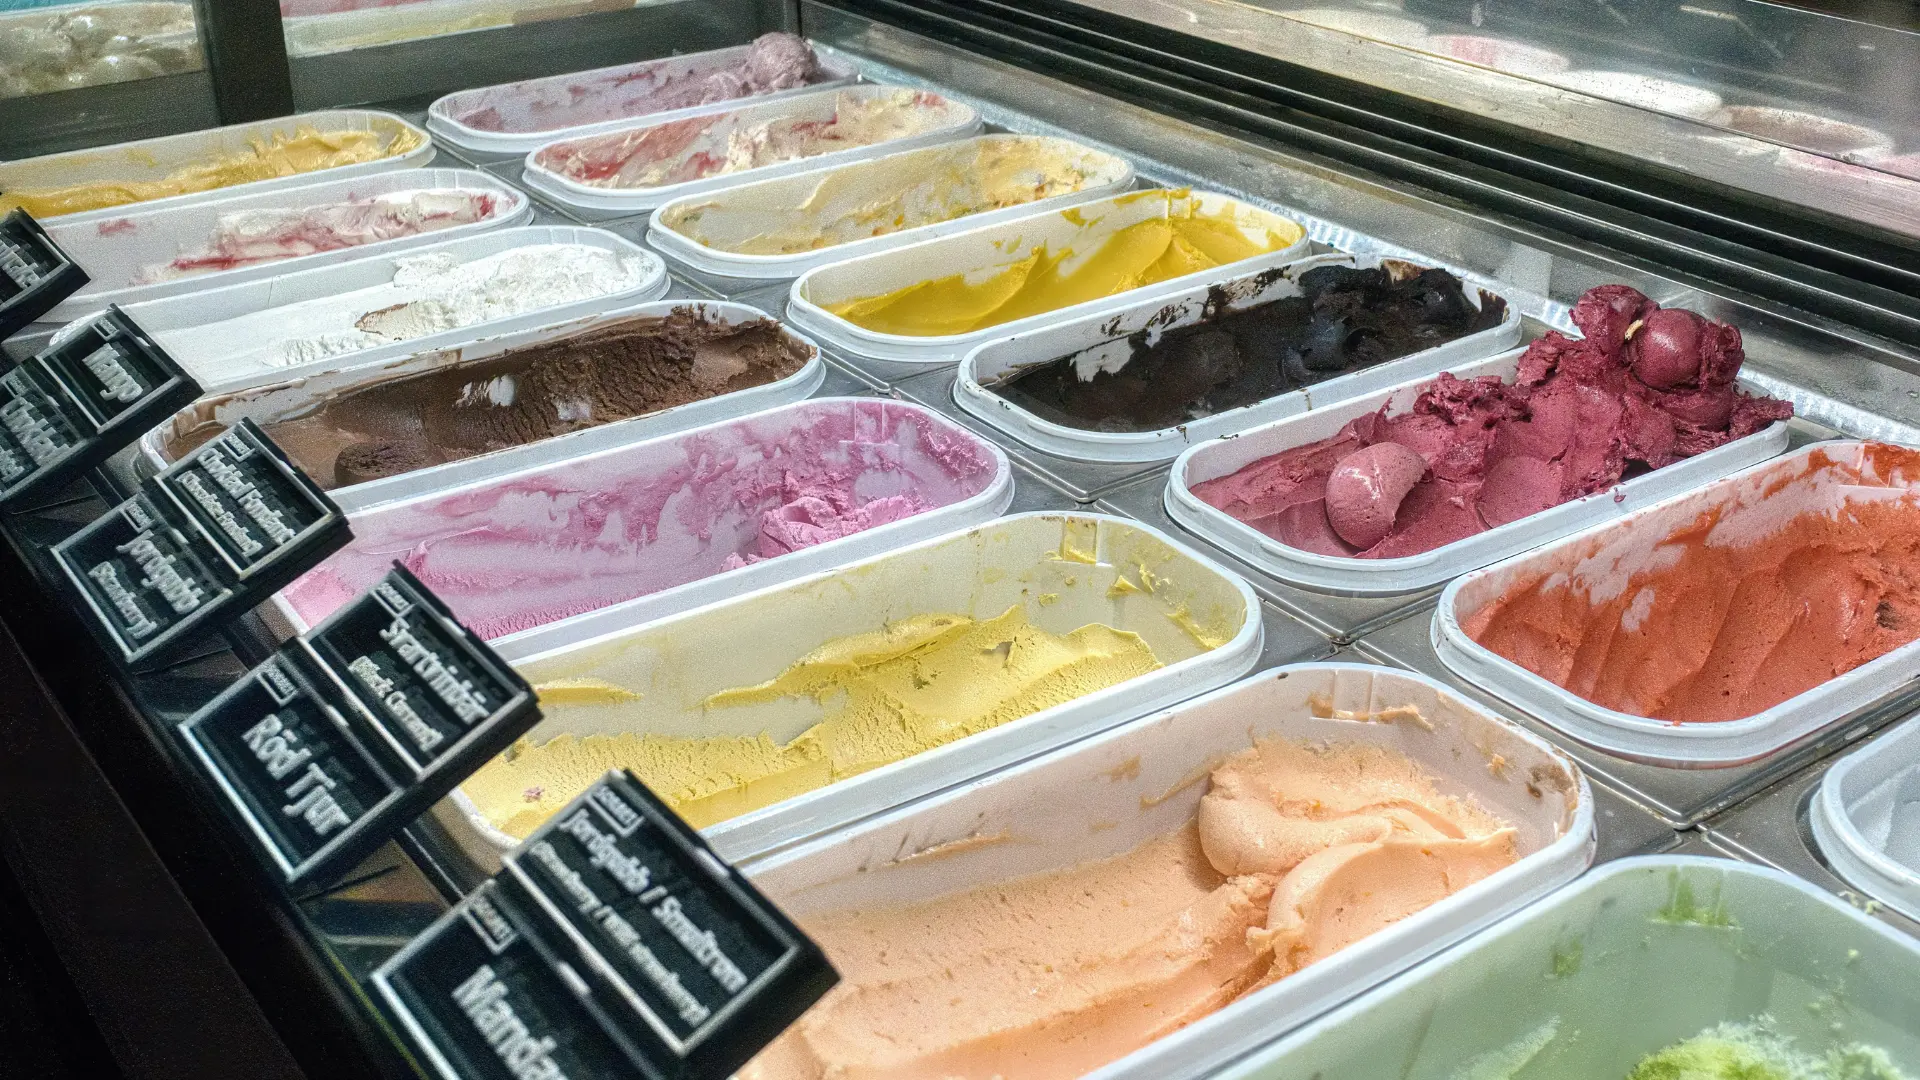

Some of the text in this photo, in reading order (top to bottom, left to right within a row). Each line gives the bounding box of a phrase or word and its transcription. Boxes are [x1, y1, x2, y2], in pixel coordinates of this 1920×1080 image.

[82, 343, 143, 400] Mango
[197, 448, 297, 546] Choklad Fondant
[88, 561, 157, 639] (Strawberry)
[116, 530, 204, 614] Jordgubb
[379, 616, 490, 725] Svartvinbär
[384, 690, 444, 752] Currant)
[242, 713, 351, 835] Röd Tjur
[559, 808, 651, 893] Jordgubb
[651, 895, 748, 994] Smultron
